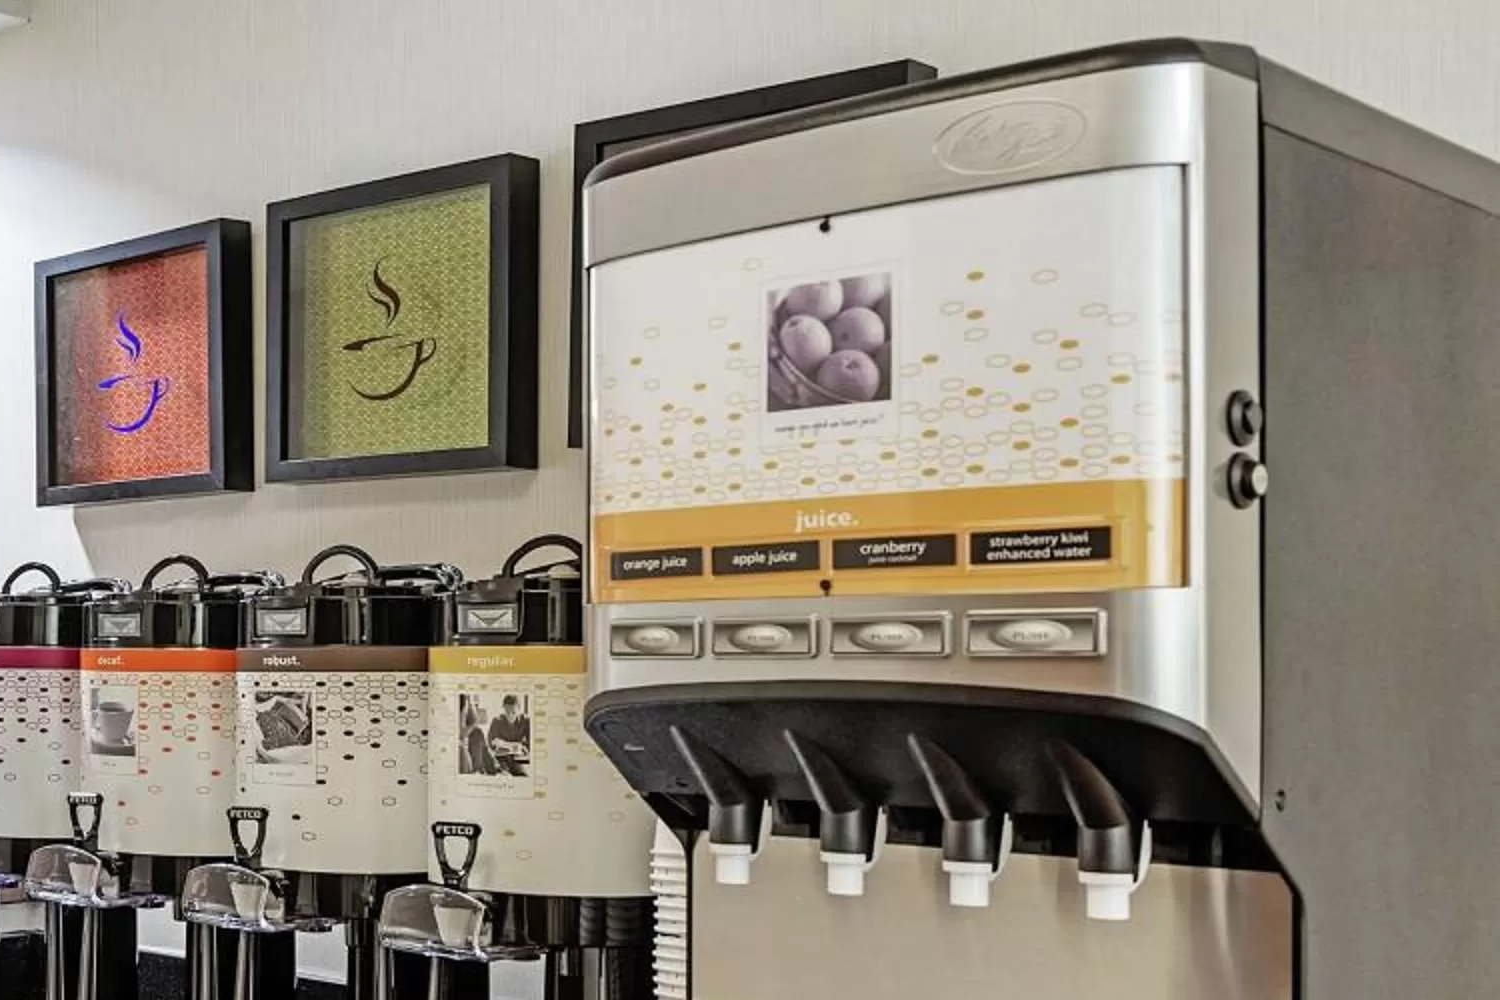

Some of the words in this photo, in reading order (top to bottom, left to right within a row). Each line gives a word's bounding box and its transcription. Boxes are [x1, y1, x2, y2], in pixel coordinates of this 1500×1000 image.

[796, 509, 860, 532] juice.
[989, 533, 1058, 548] strawberry
[1061, 532, 1089, 544] kiwi
[859, 541, 927, 555] cranberry
[986, 547, 1050, 561] enhanced
[1053, 547, 1093, 558] water
[623, 559, 661, 572] orange
[662, 555, 688, 570] juice
[732, 553, 765, 566] apple
[768, 550, 798, 564] juice
[263, 655, 301, 666] robust.
[230, 809, 261, 819] FETCO
[435, 824, 474, 836] FETCO
